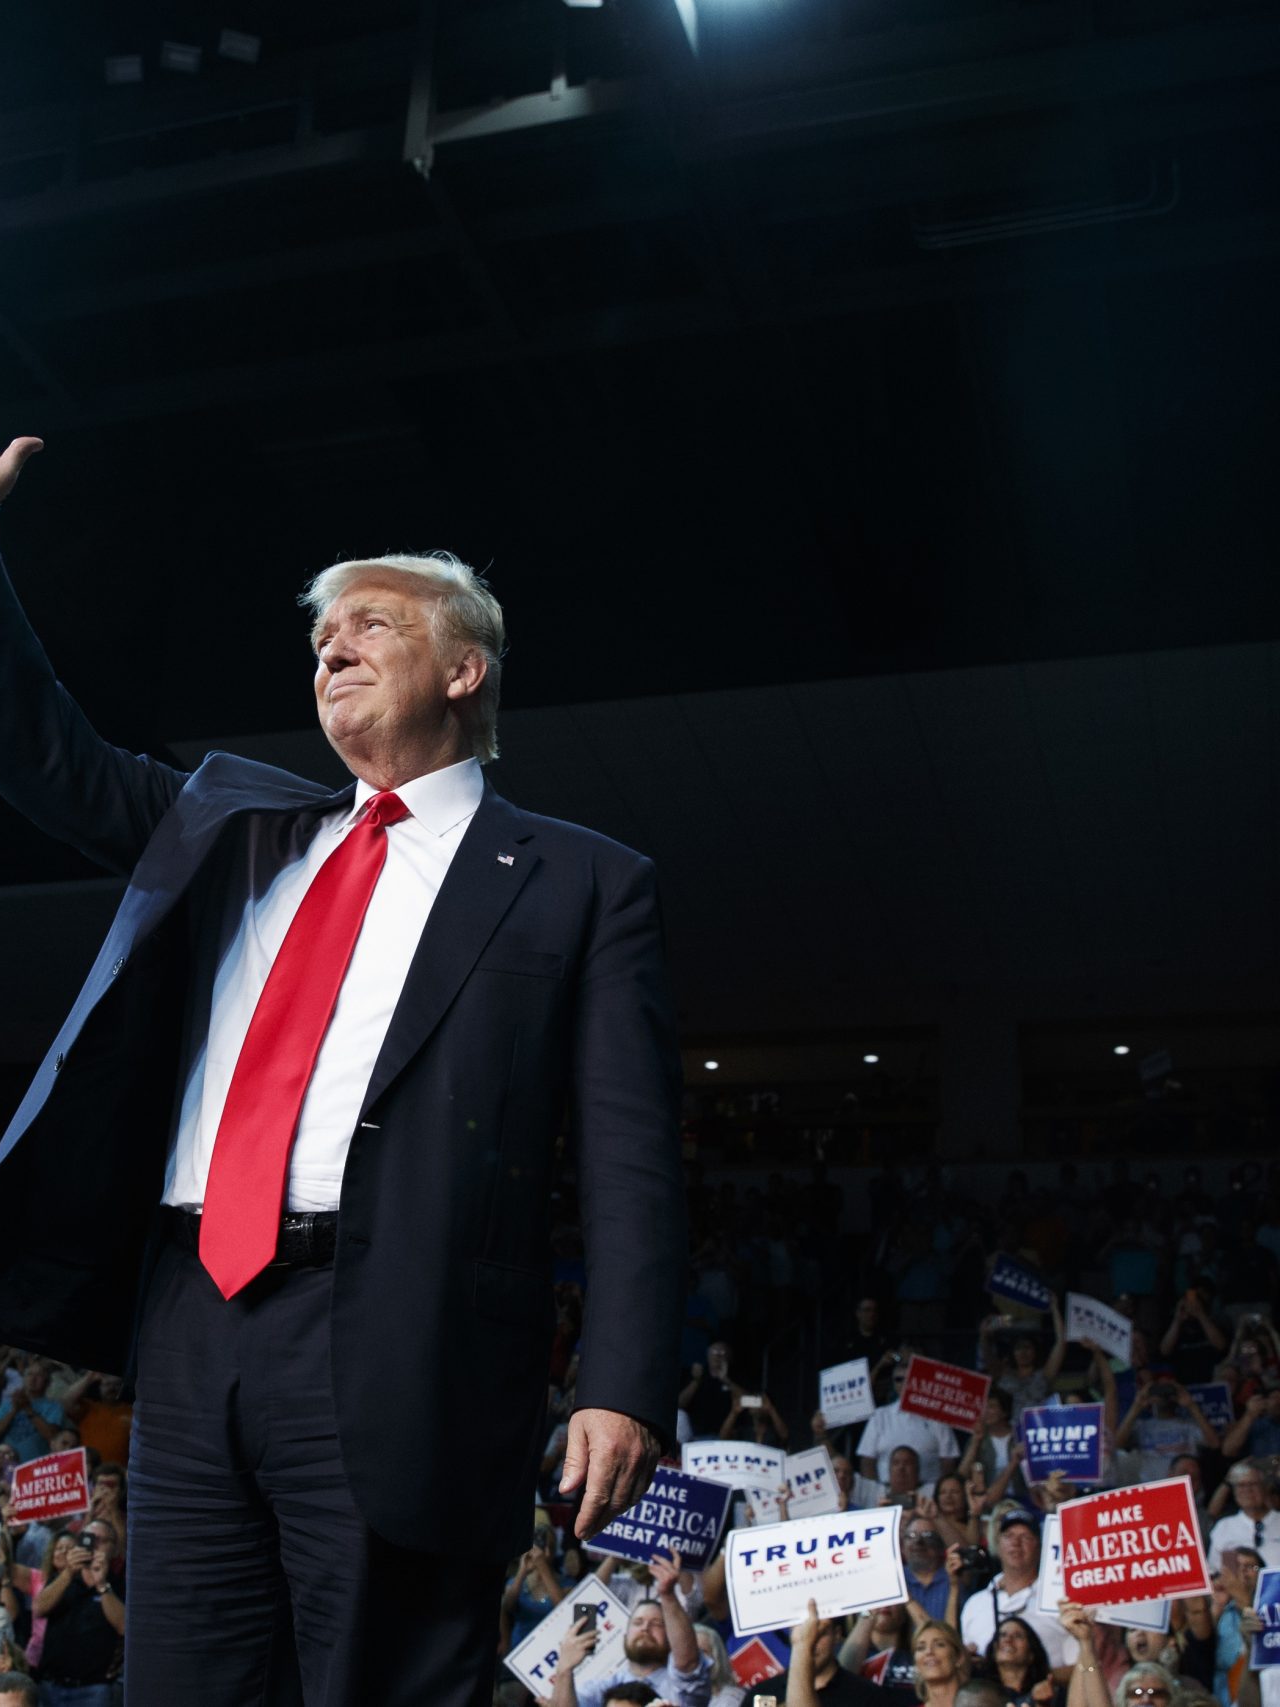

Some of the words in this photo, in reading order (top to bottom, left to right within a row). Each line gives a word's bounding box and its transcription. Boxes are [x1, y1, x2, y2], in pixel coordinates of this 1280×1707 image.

[823, 1376, 866, 1396] TRUMP
[934, 1371, 963, 1386] MAKE
[908, 1393, 941, 1410] GREAT
[942, 1402, 976, 1419] AGAIN
[910, 1376, 985, 1411] AMERICA
[1026, 1424, 1098, 1444] TRUMP
[1030, 1441, 1089, 1454] PENCE
[32, 1463, 60, 1478] MAKE
[691, 1455, 779, 1467] TRUMP
[13, 1471, 85, 1500] AMERICA
[15, 1498, 46, 1512] GREAT
[48, 1491, 81, 1504] AGAIN
[1097, 1504, 1144, 1528] MAKE
[602, 1522, 656, 1545] GREAT
[656, 1533, 708, 1556] AGAIN
[739, 1526, 885, 1567] TRUMP
[1063, 1521, 1196, 1568] AMERICA
[752, 1547, 871, 1582] PENCE
[1071, 1563, 1126, 1589] GREAT
[1131, 1554, 1192, 1580] AGAIN
[776, 1577, 815, 1591] AMERICA
[530, 1601, 609, 1678] TRP
